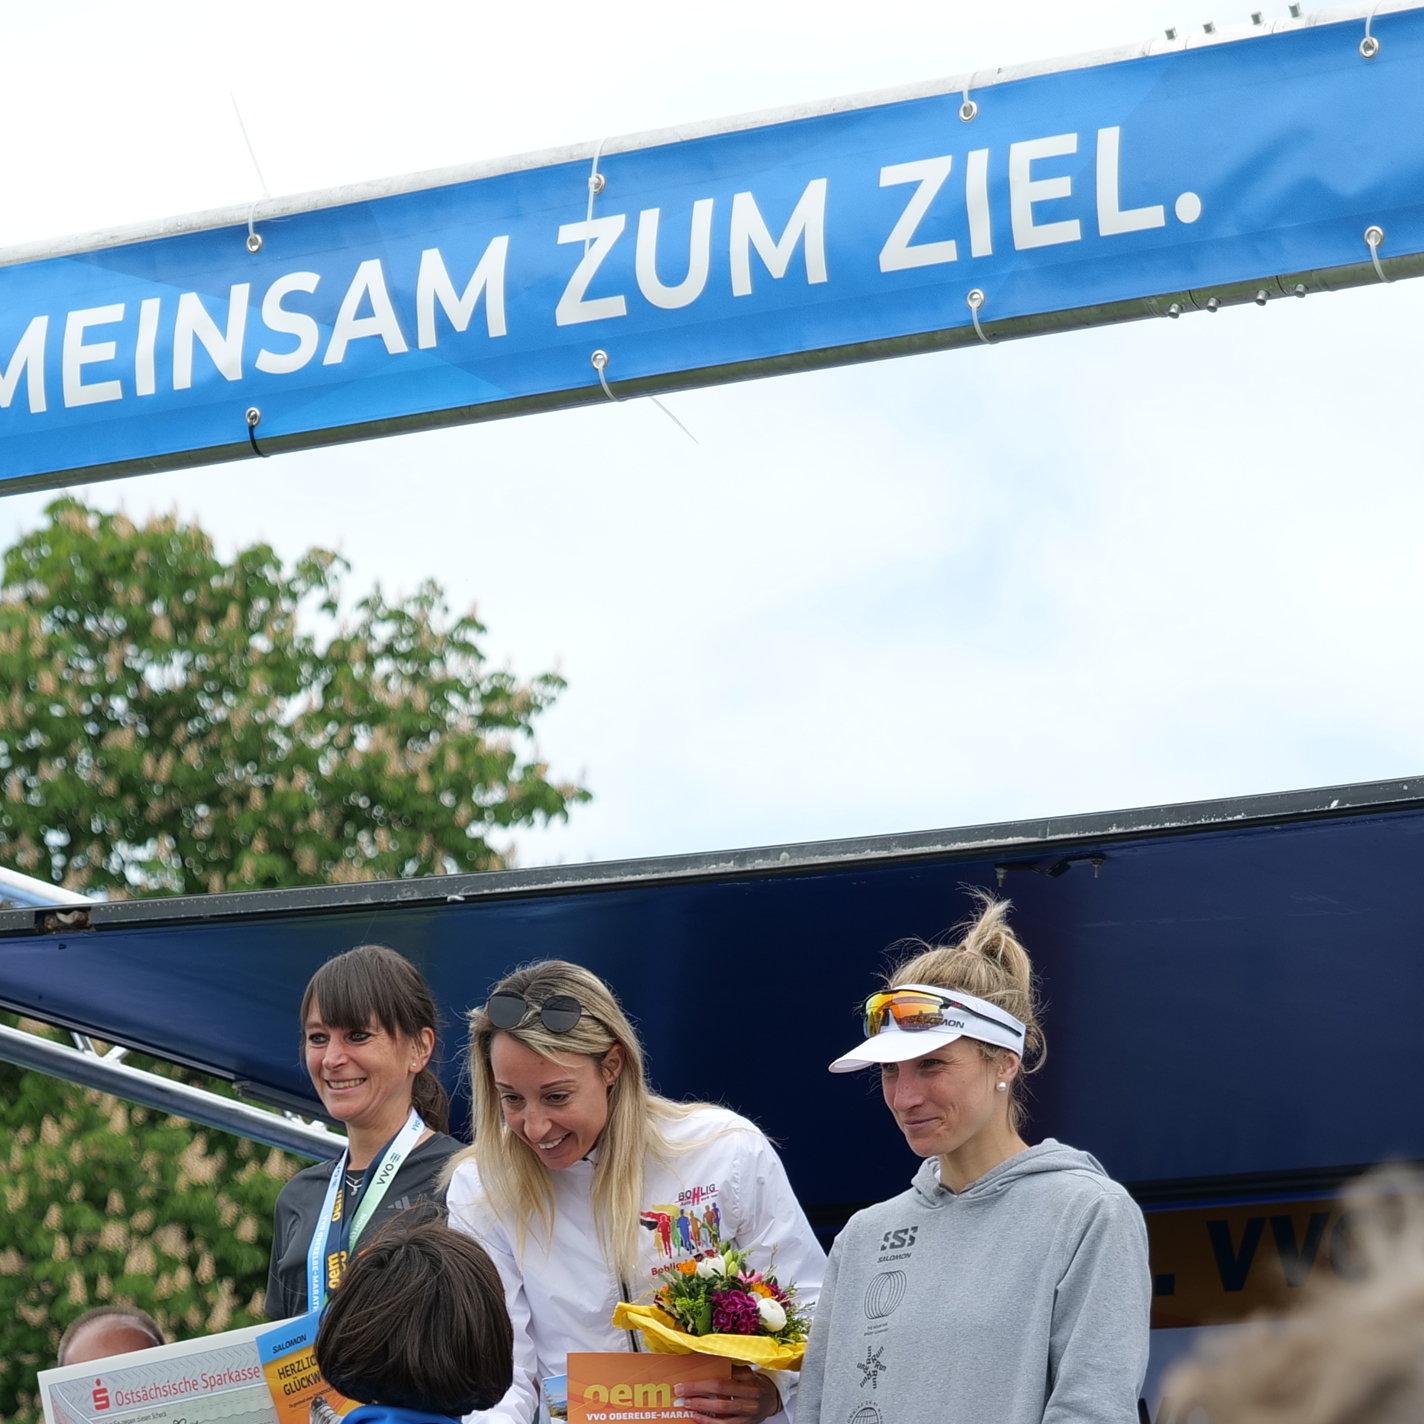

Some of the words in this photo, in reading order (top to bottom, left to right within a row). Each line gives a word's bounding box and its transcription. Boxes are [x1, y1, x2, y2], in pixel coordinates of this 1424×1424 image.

[555, 178, 829, 327] ZUM
[878, 126, 1202, 272] ZIEL.
[877, 1252, 912, 1264] SALOMON
[272, 1333, 307, 1355] SALOMON
[277, 1354, 318, 1381] HERZLIC
[115, 1374, 199, 1407] Ostsächsische
[201, 1364, 261, 1393] Sparkasse
[582, 1383, 672, 1410] oem
[586, 1412, 608, 1422] VVO
